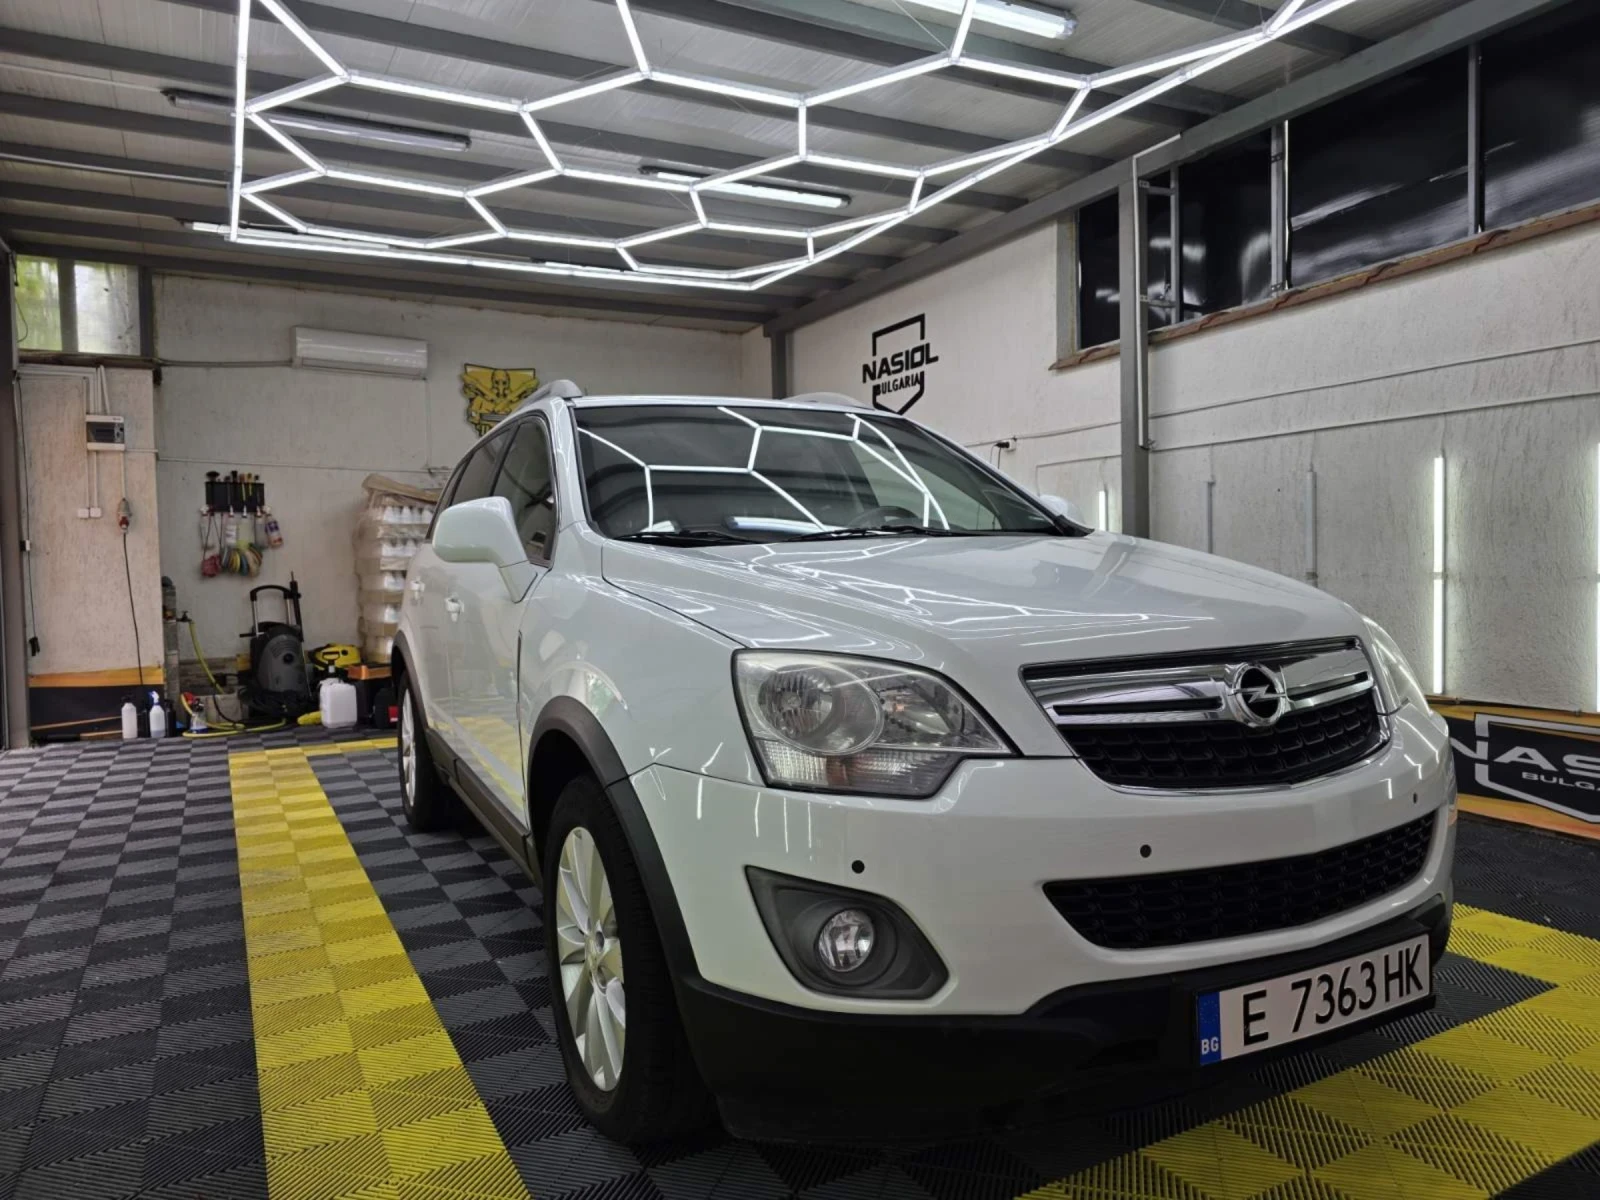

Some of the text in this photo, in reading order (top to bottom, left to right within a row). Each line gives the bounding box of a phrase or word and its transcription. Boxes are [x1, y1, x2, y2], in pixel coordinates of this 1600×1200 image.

[862, 342, 939, 384] NASIOL
[874, 374, 921, 396] BULGARIA
[1521, 771, 1600, 791] BULG
[1242, 989, 1269, 1046] E
[1200, 1036, 1219, 1055] BG
